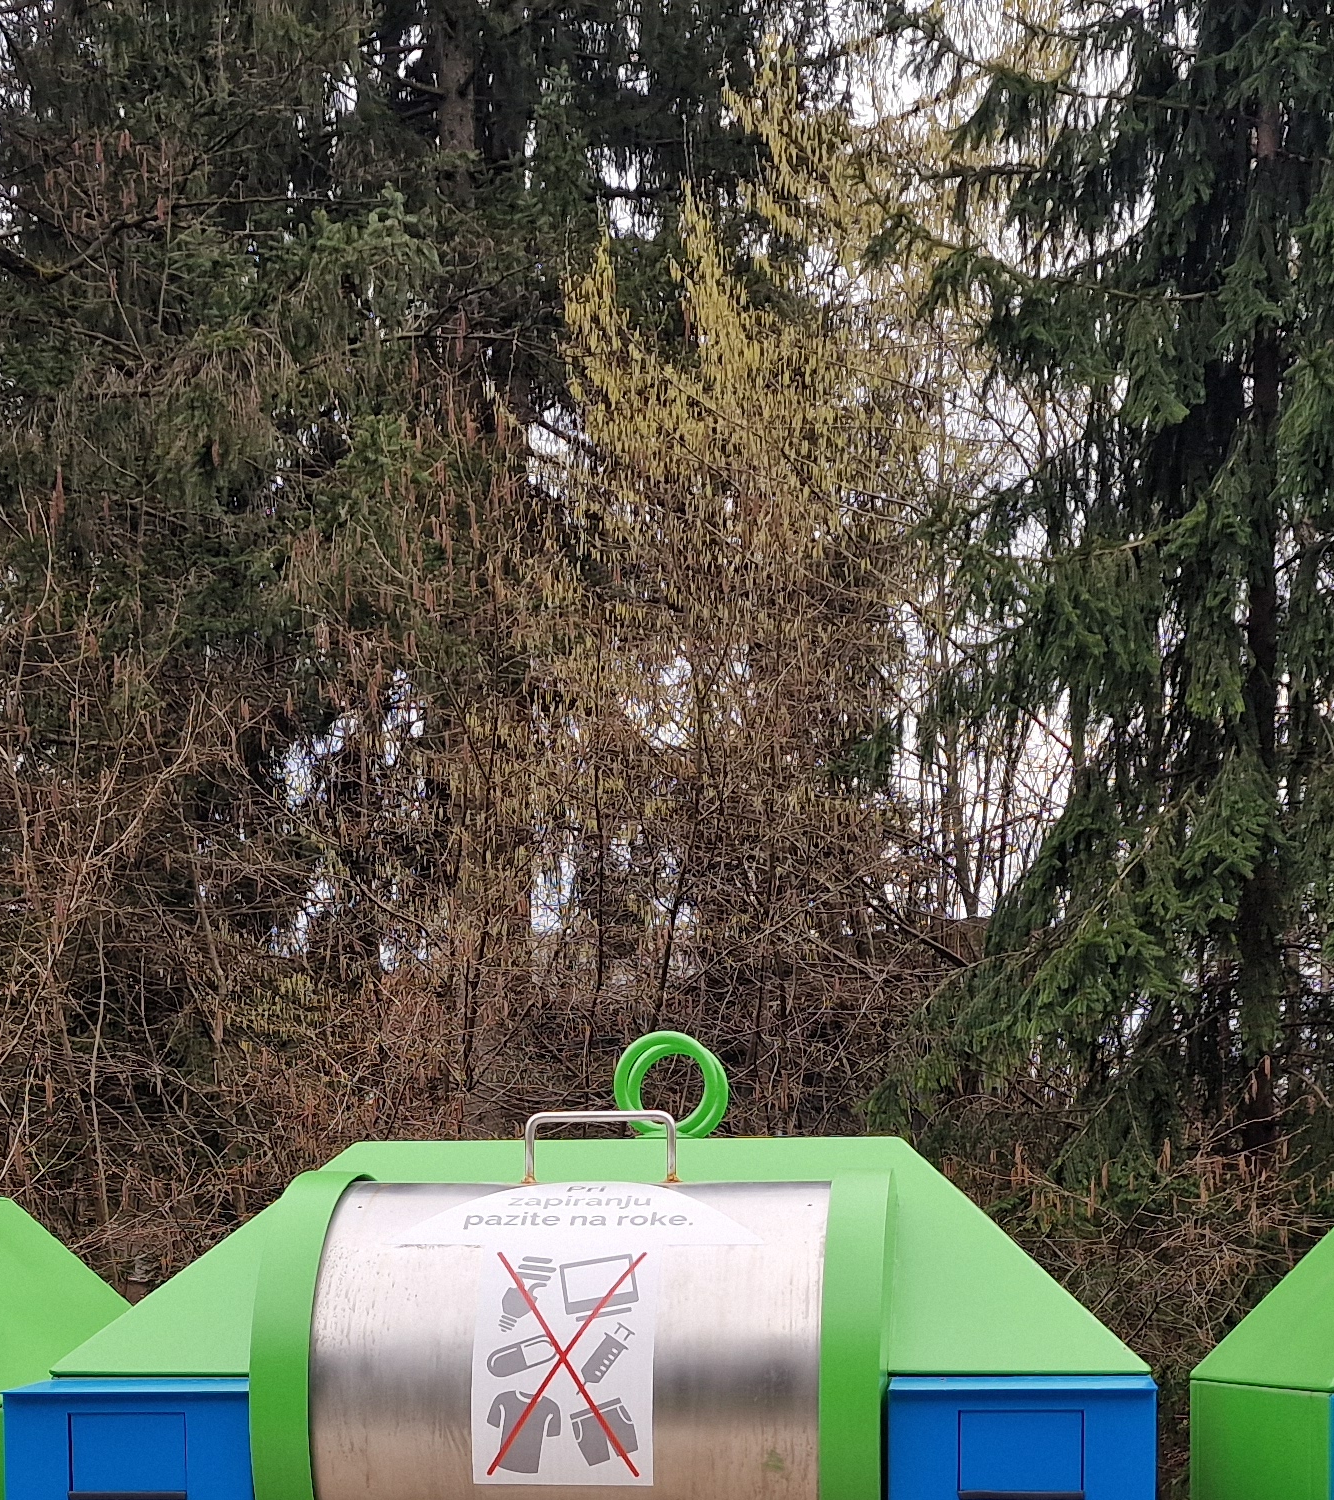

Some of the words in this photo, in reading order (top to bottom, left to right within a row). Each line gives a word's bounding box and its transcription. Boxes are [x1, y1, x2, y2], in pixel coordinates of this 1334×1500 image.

[508, 1196, 652, 1209] zapiranju
[463, 1212, 561, 1230] pazite
[569, 1215, 606, 1226] na
[617, 1212, 694, 1226] roke.
